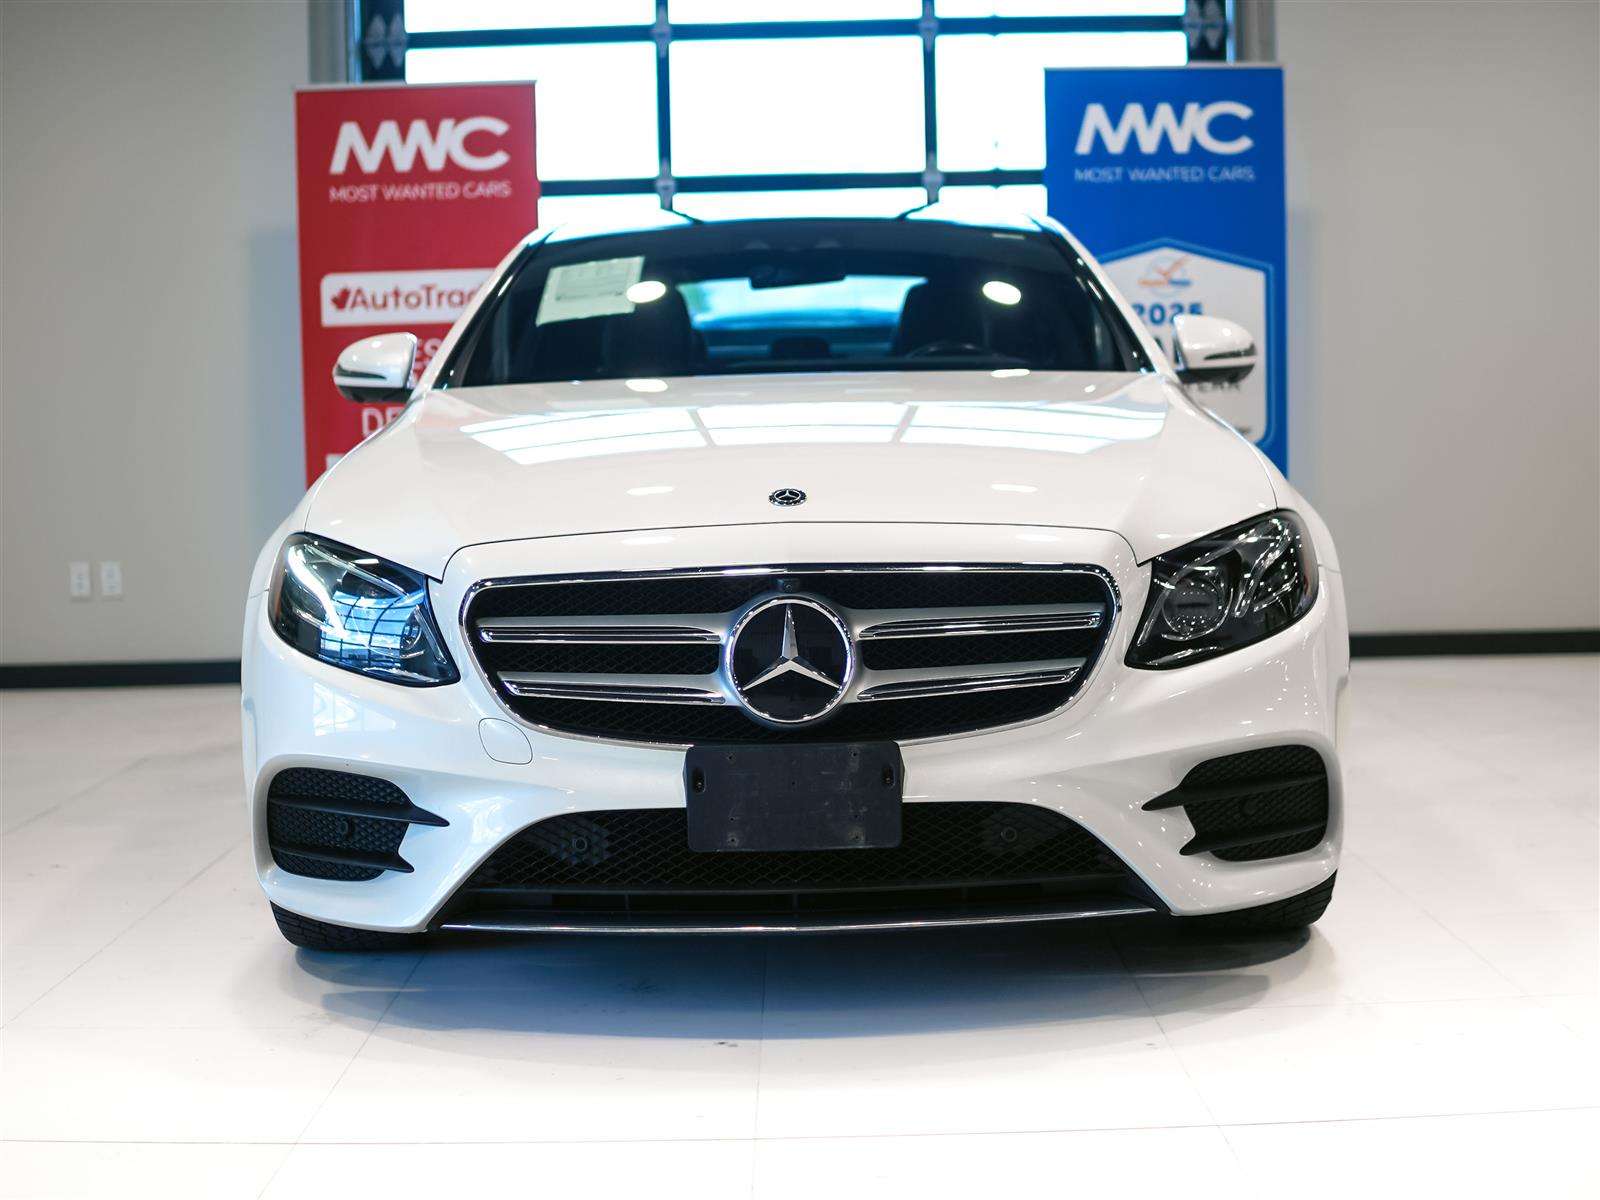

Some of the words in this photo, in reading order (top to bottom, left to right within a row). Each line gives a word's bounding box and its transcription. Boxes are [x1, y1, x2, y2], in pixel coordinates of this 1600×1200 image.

[329, 116, 510, 175] MWC
[1074, 101, 1254, 155] MWC
[329, 184, 378, 203] MOST
[382, 182, 460, 201] WANTED
[462, 180, 512, 199] CARS
[1074, 165, 1122, 183] MOST
[1128, 165, 1203, 182] WANTED
[1207, 164, 1256, 182] CARS
